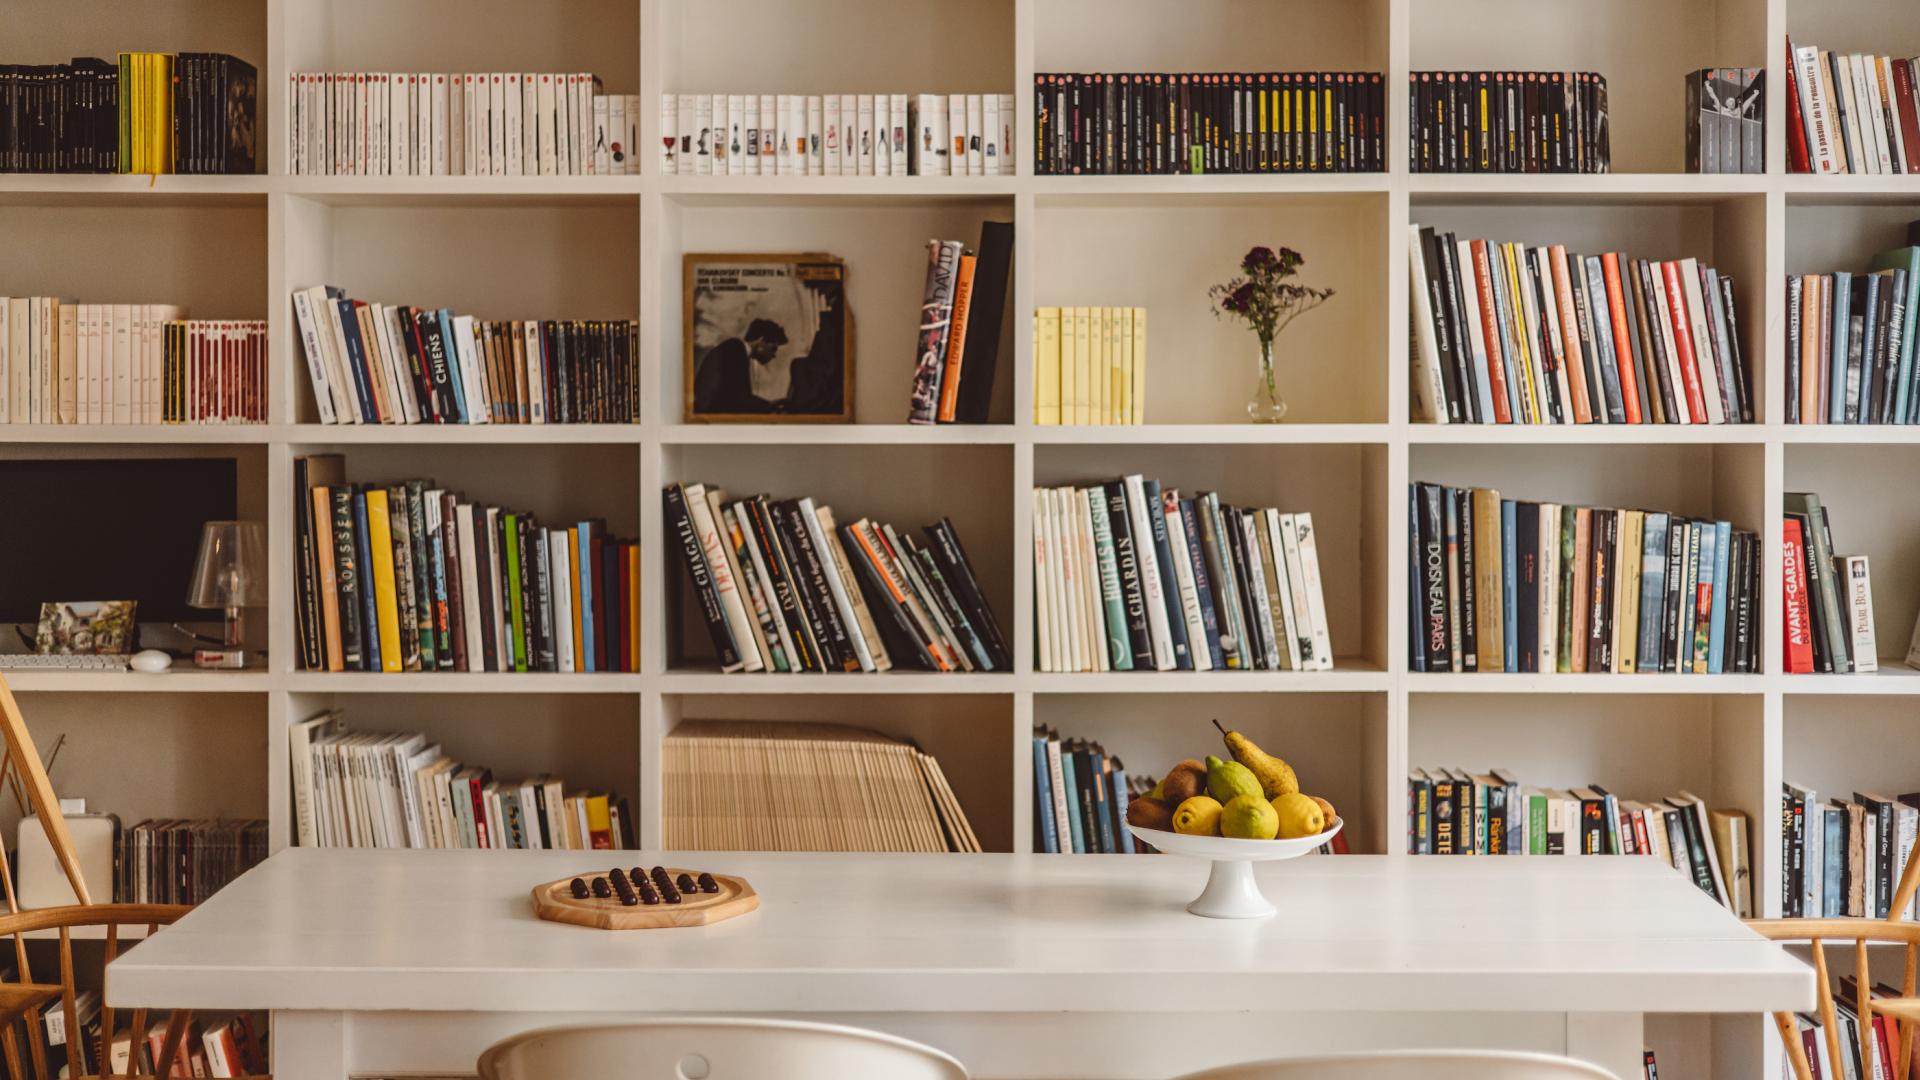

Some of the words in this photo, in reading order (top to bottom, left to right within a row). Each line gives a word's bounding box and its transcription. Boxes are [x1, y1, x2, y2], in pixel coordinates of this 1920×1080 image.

[1806, 66, 1818, 101] rencontre
[1814, 111, 1821, 119] de
[1815, 120, 1828, 146] passion
[1819, 148, 1829, 156] La
[934, 245, 954, 300] DAVID
[953, 281, 969, 321] HOPPER
[429, 333, 447, 384] CHIENS
[792, 511, 806, 538] Christ
[1089, 485, 1112, 541] DESIGN
[1150, 495, 1165, 542] MORALES
[336, 492, 354, 593] ROUSSEAU
[677, 515, 709, 586] CHAGALL
[702, 531, 734, 593] DEGAS
[801, 538, 812, 549] du
[808, 550, 821, 575] figure
[1691, 528, 1700, 553] HAUS
[1808, 544, 1818, 580] BALTHUS
[817, 584, 828, 594] et
[1098, 546, 1121, 601] HOTELS
[1118, 536, 1143, 616] CHARDIN
[1190, 543, 1206, 591] CHAGALL
[1689, 555, 1698, 595] MONETS
[1783, 541, 1802, 645] AVANT-GARDES
[823, 595, 845, 641] Rembrandt
[1738, 596, 1747, 642] MATISSE
